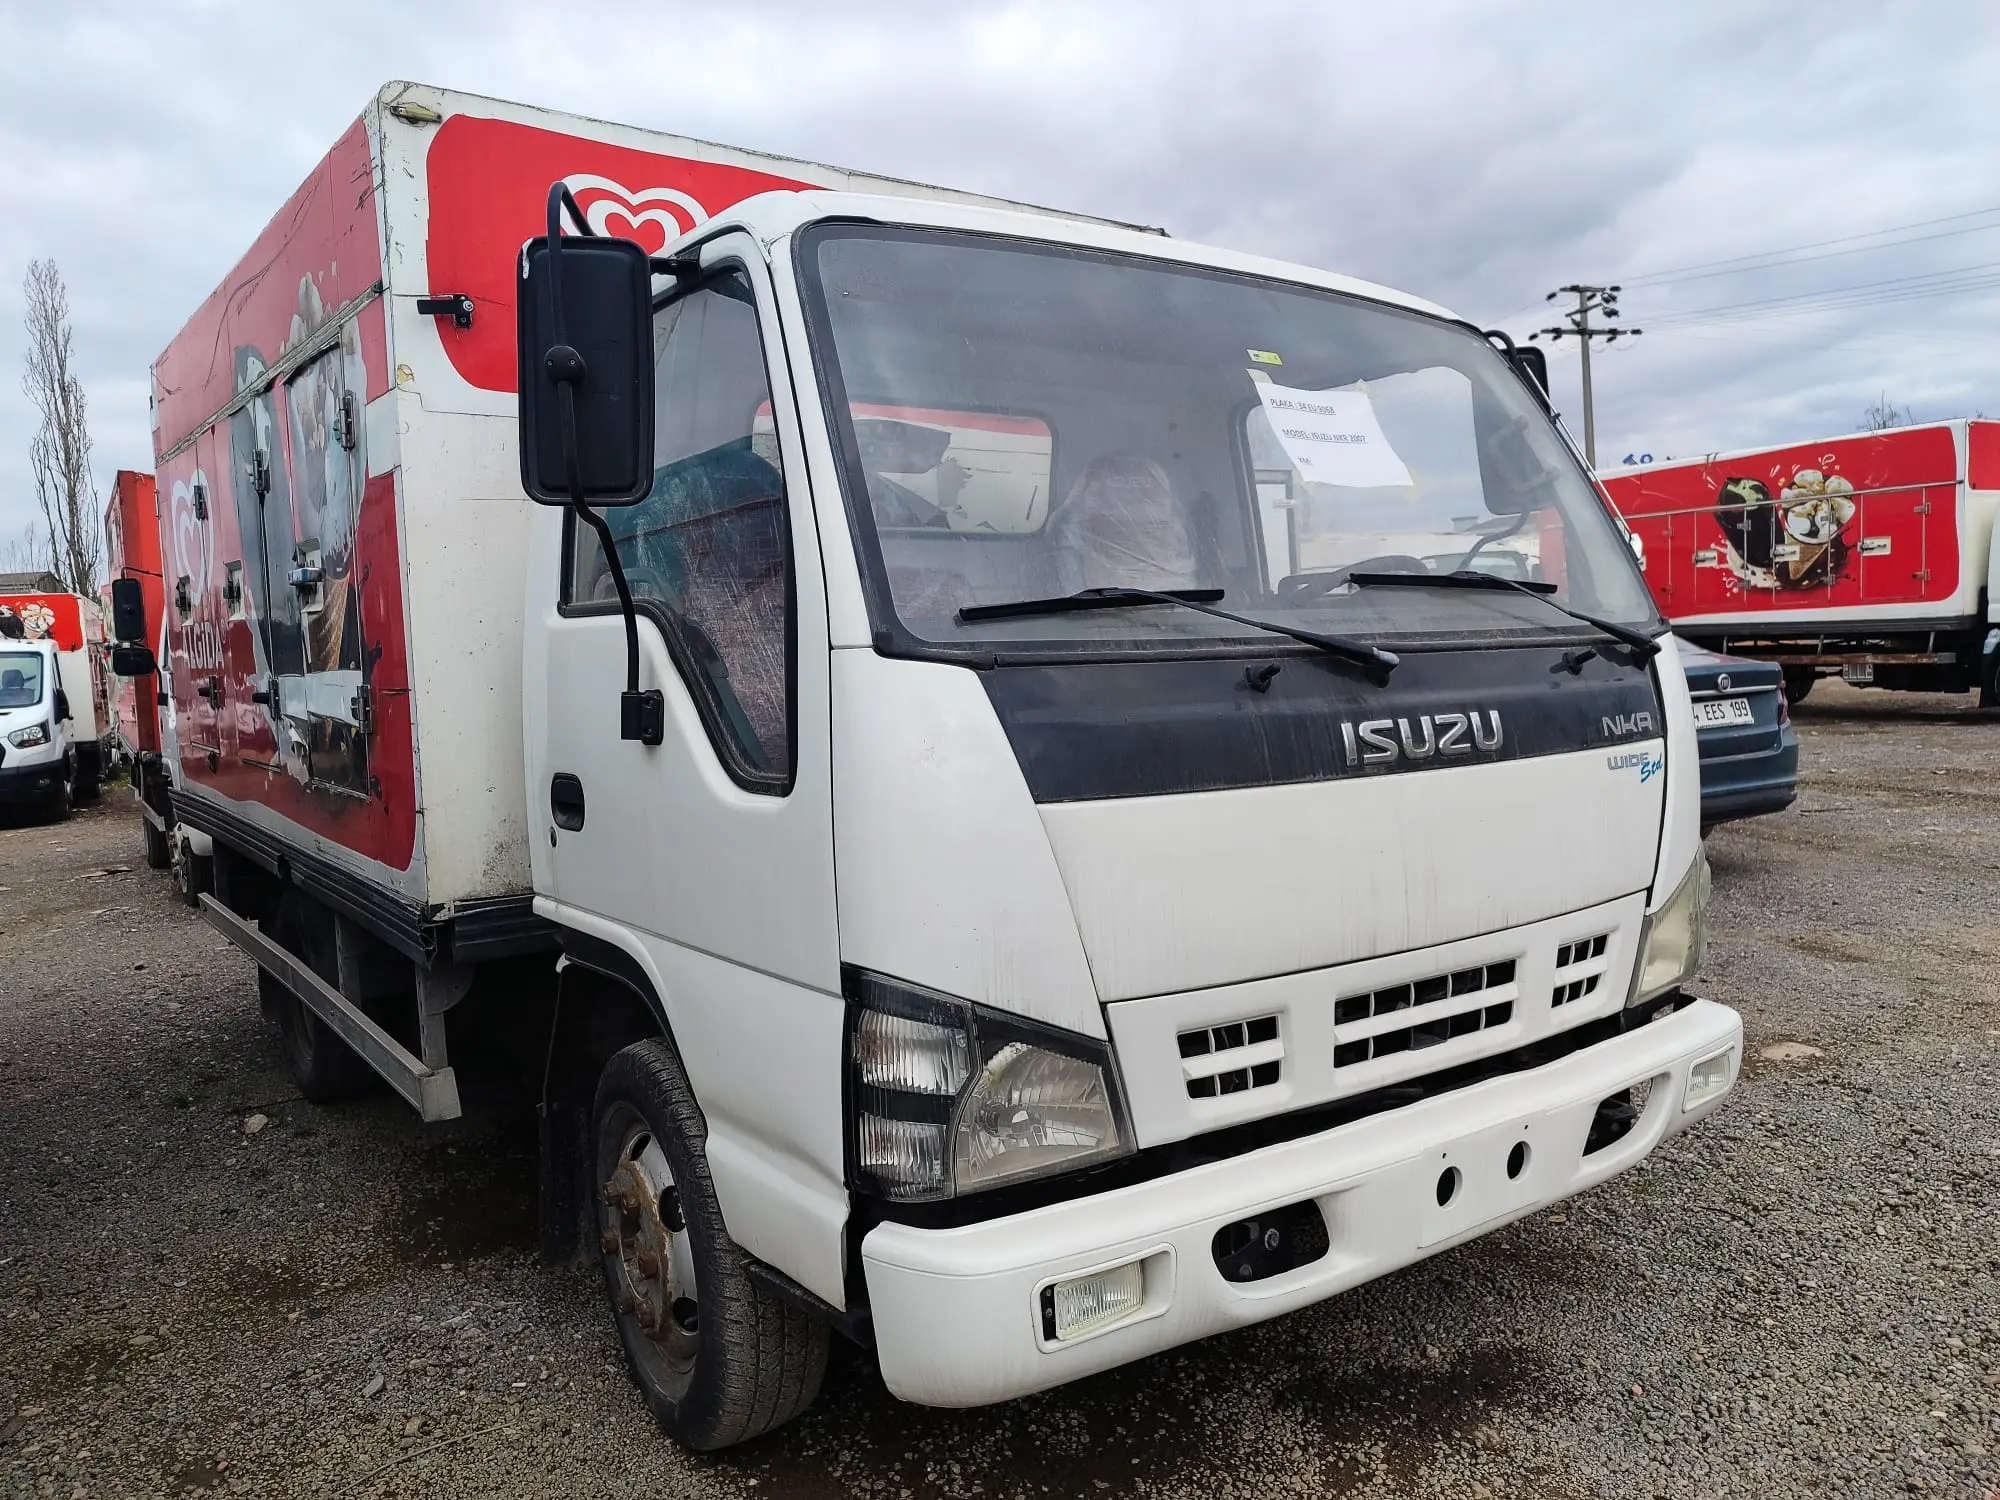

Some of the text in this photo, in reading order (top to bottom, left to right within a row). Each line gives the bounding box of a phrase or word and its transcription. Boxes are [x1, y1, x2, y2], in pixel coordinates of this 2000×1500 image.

[1270, 398, 1294, 408] PLAKA
[1312, 432, 1333, 441] ISUZU
[1703, 703, 1726, 721] EES
[1730, 700, 1749, 718] 199
[1602, 711, 1653, 736] NKR
[1340, 709, 1503, 767] ISUZU
[1640, 752, 1663, 783] Std
